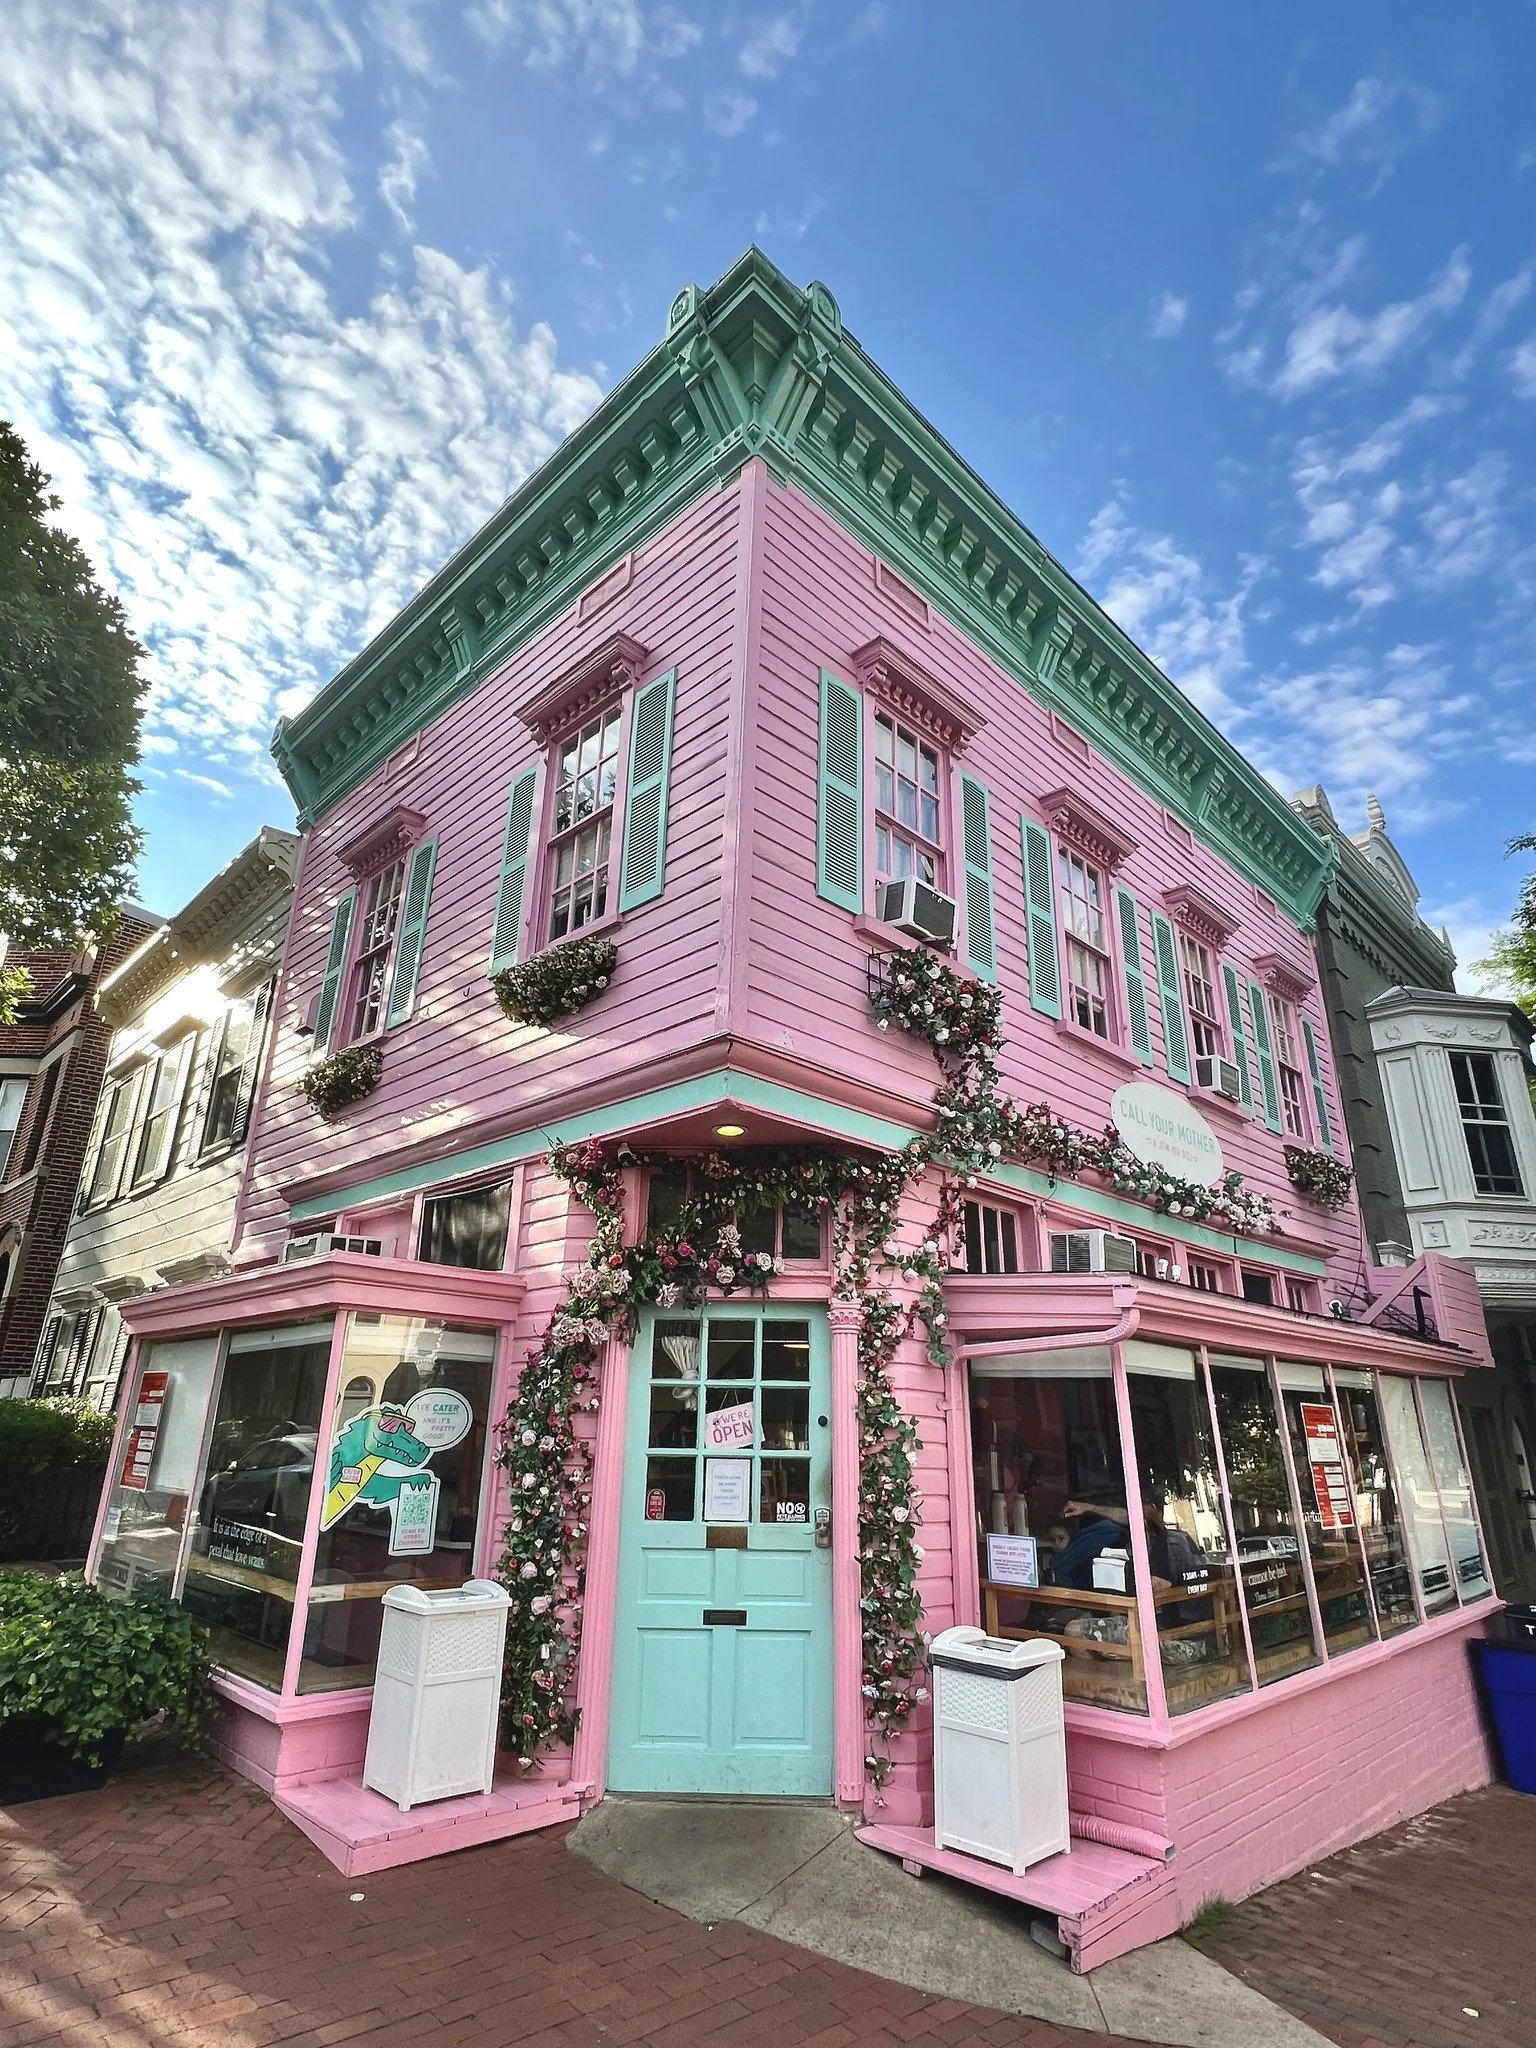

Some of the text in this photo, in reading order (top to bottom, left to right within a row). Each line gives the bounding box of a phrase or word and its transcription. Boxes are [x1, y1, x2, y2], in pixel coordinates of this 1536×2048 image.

[1120, 1099, 1216, 1155] CALL YOUR MOTHER
[417, 1403, 460, 1412] WE CATER
[713, 1420, 753, 1444] OPEN
[776, 1501, 795, 1515] NO
[1187, 1583, 1208, 1595] EVERY DAY
